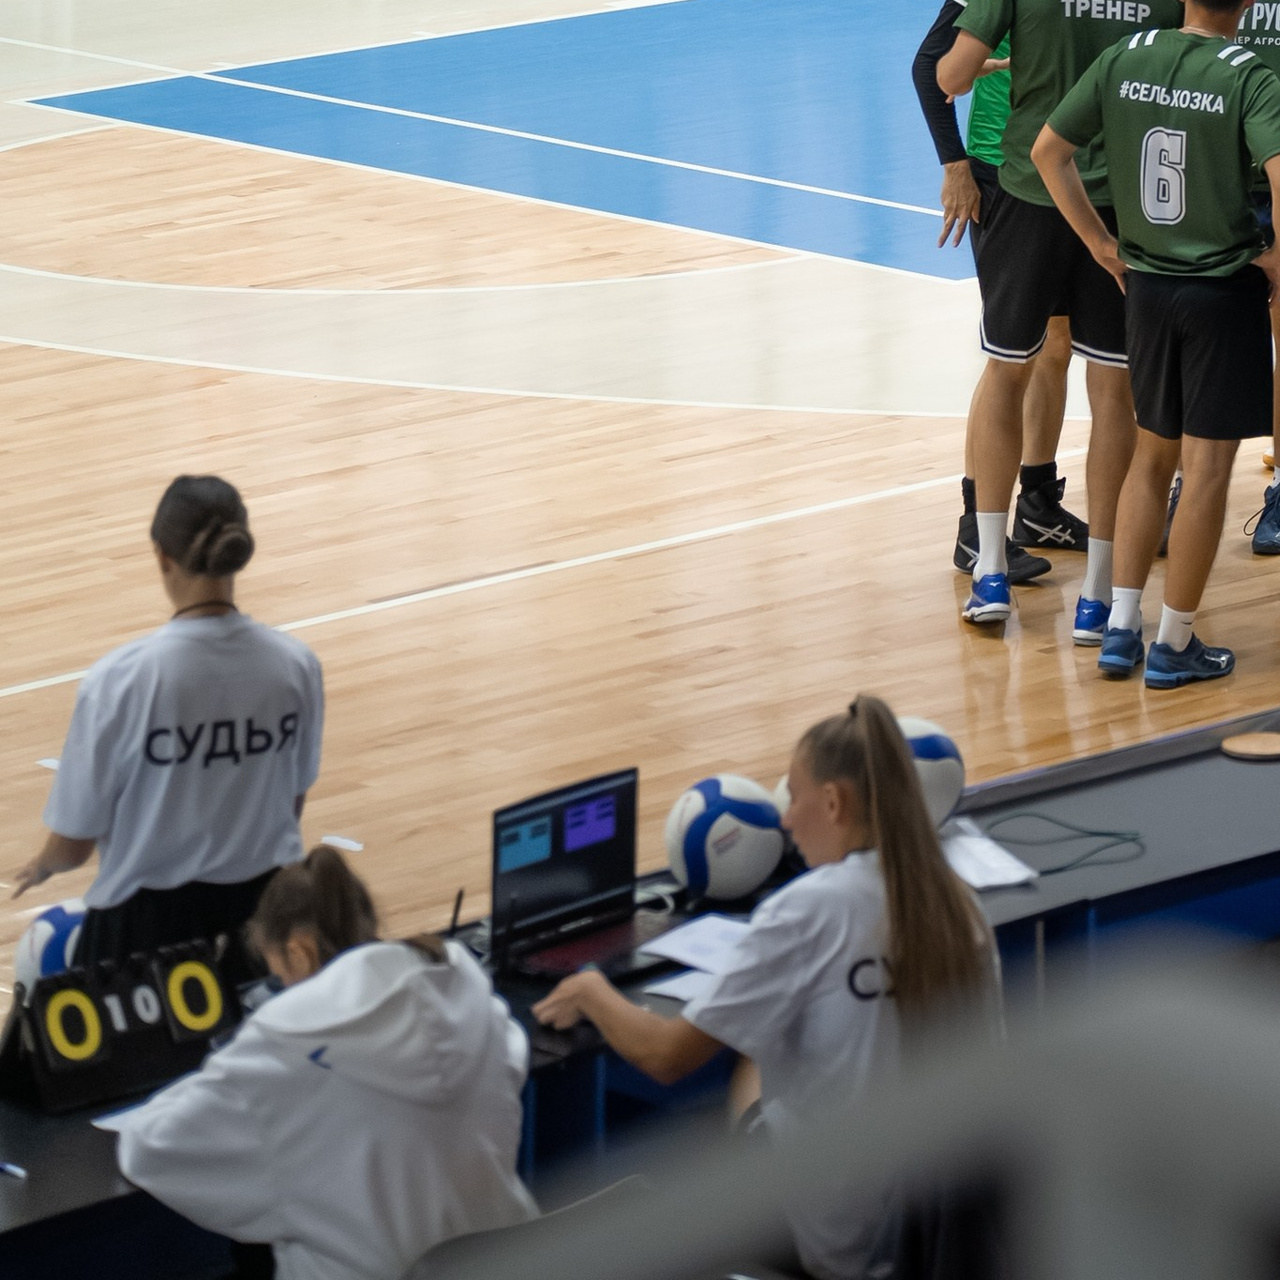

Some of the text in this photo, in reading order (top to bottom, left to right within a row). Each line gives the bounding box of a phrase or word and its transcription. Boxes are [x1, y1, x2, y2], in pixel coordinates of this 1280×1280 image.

[1119, 80, 1225, 115] #СЕЛЬХОЗКА
[1140, 126, 1187, 225] 6
[144, 711, 299, 769] СУДЬЯ
[46, 988, 102, 1061] 0
[167, 960, 223, 1032] 0
